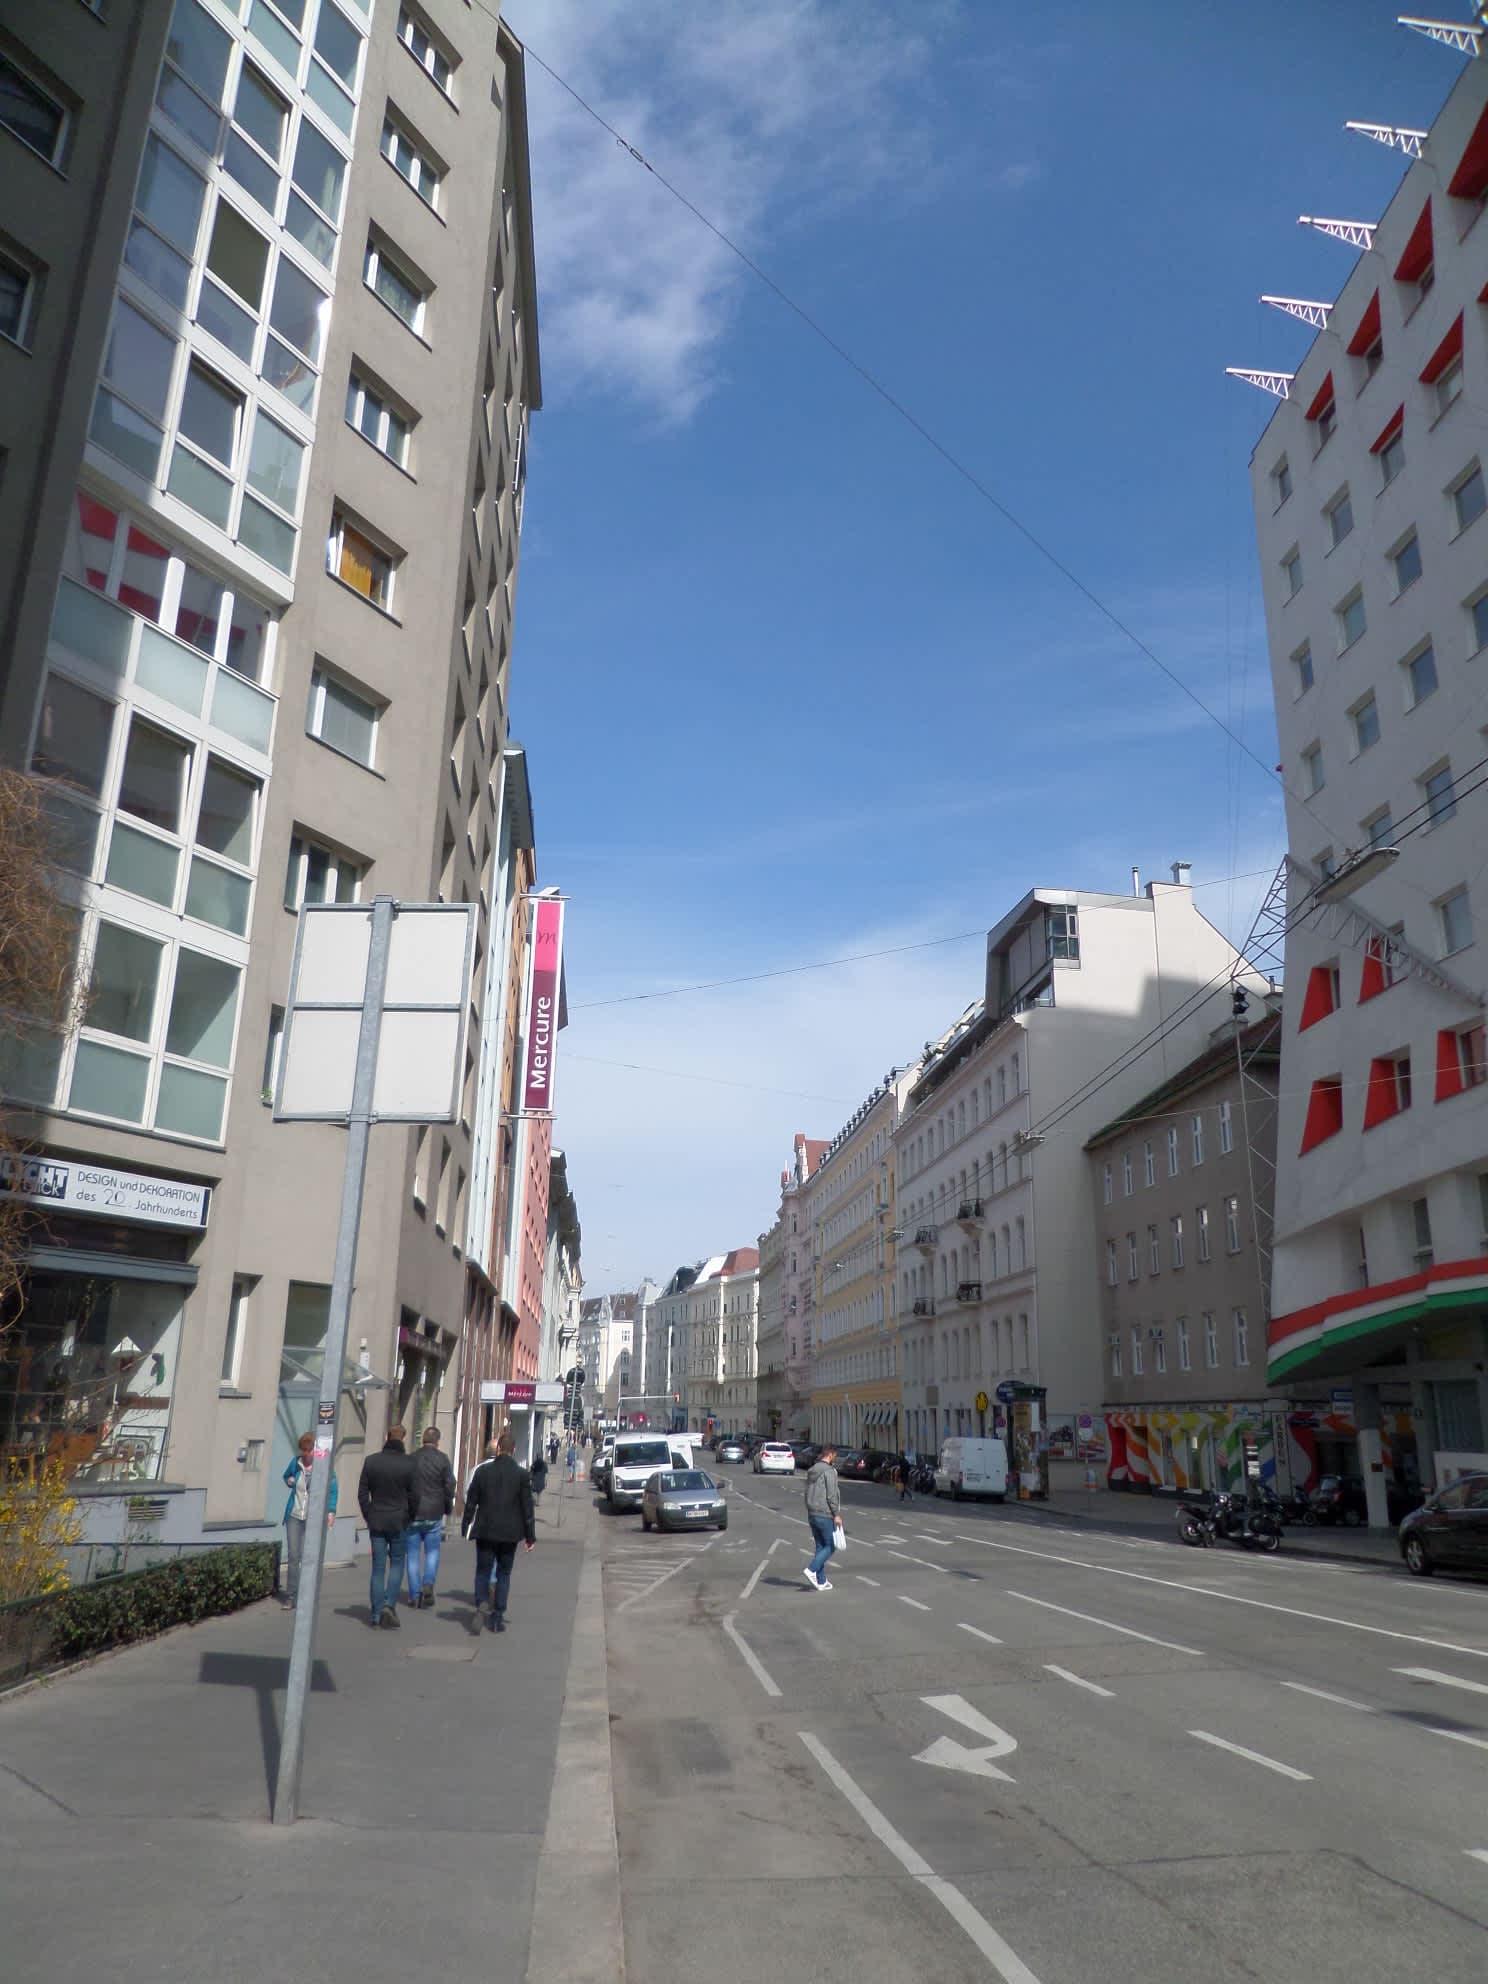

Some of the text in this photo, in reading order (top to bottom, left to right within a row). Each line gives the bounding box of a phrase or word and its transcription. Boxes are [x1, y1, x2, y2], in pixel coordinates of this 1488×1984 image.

[530, 996, 552, 1089] Mercure
[77, 1170, 200, 1203] DESIGN und DEKORATION
[75, 1188, 97, 1202] des
[134, 1199, 198, 1219] Jahrhunderts
